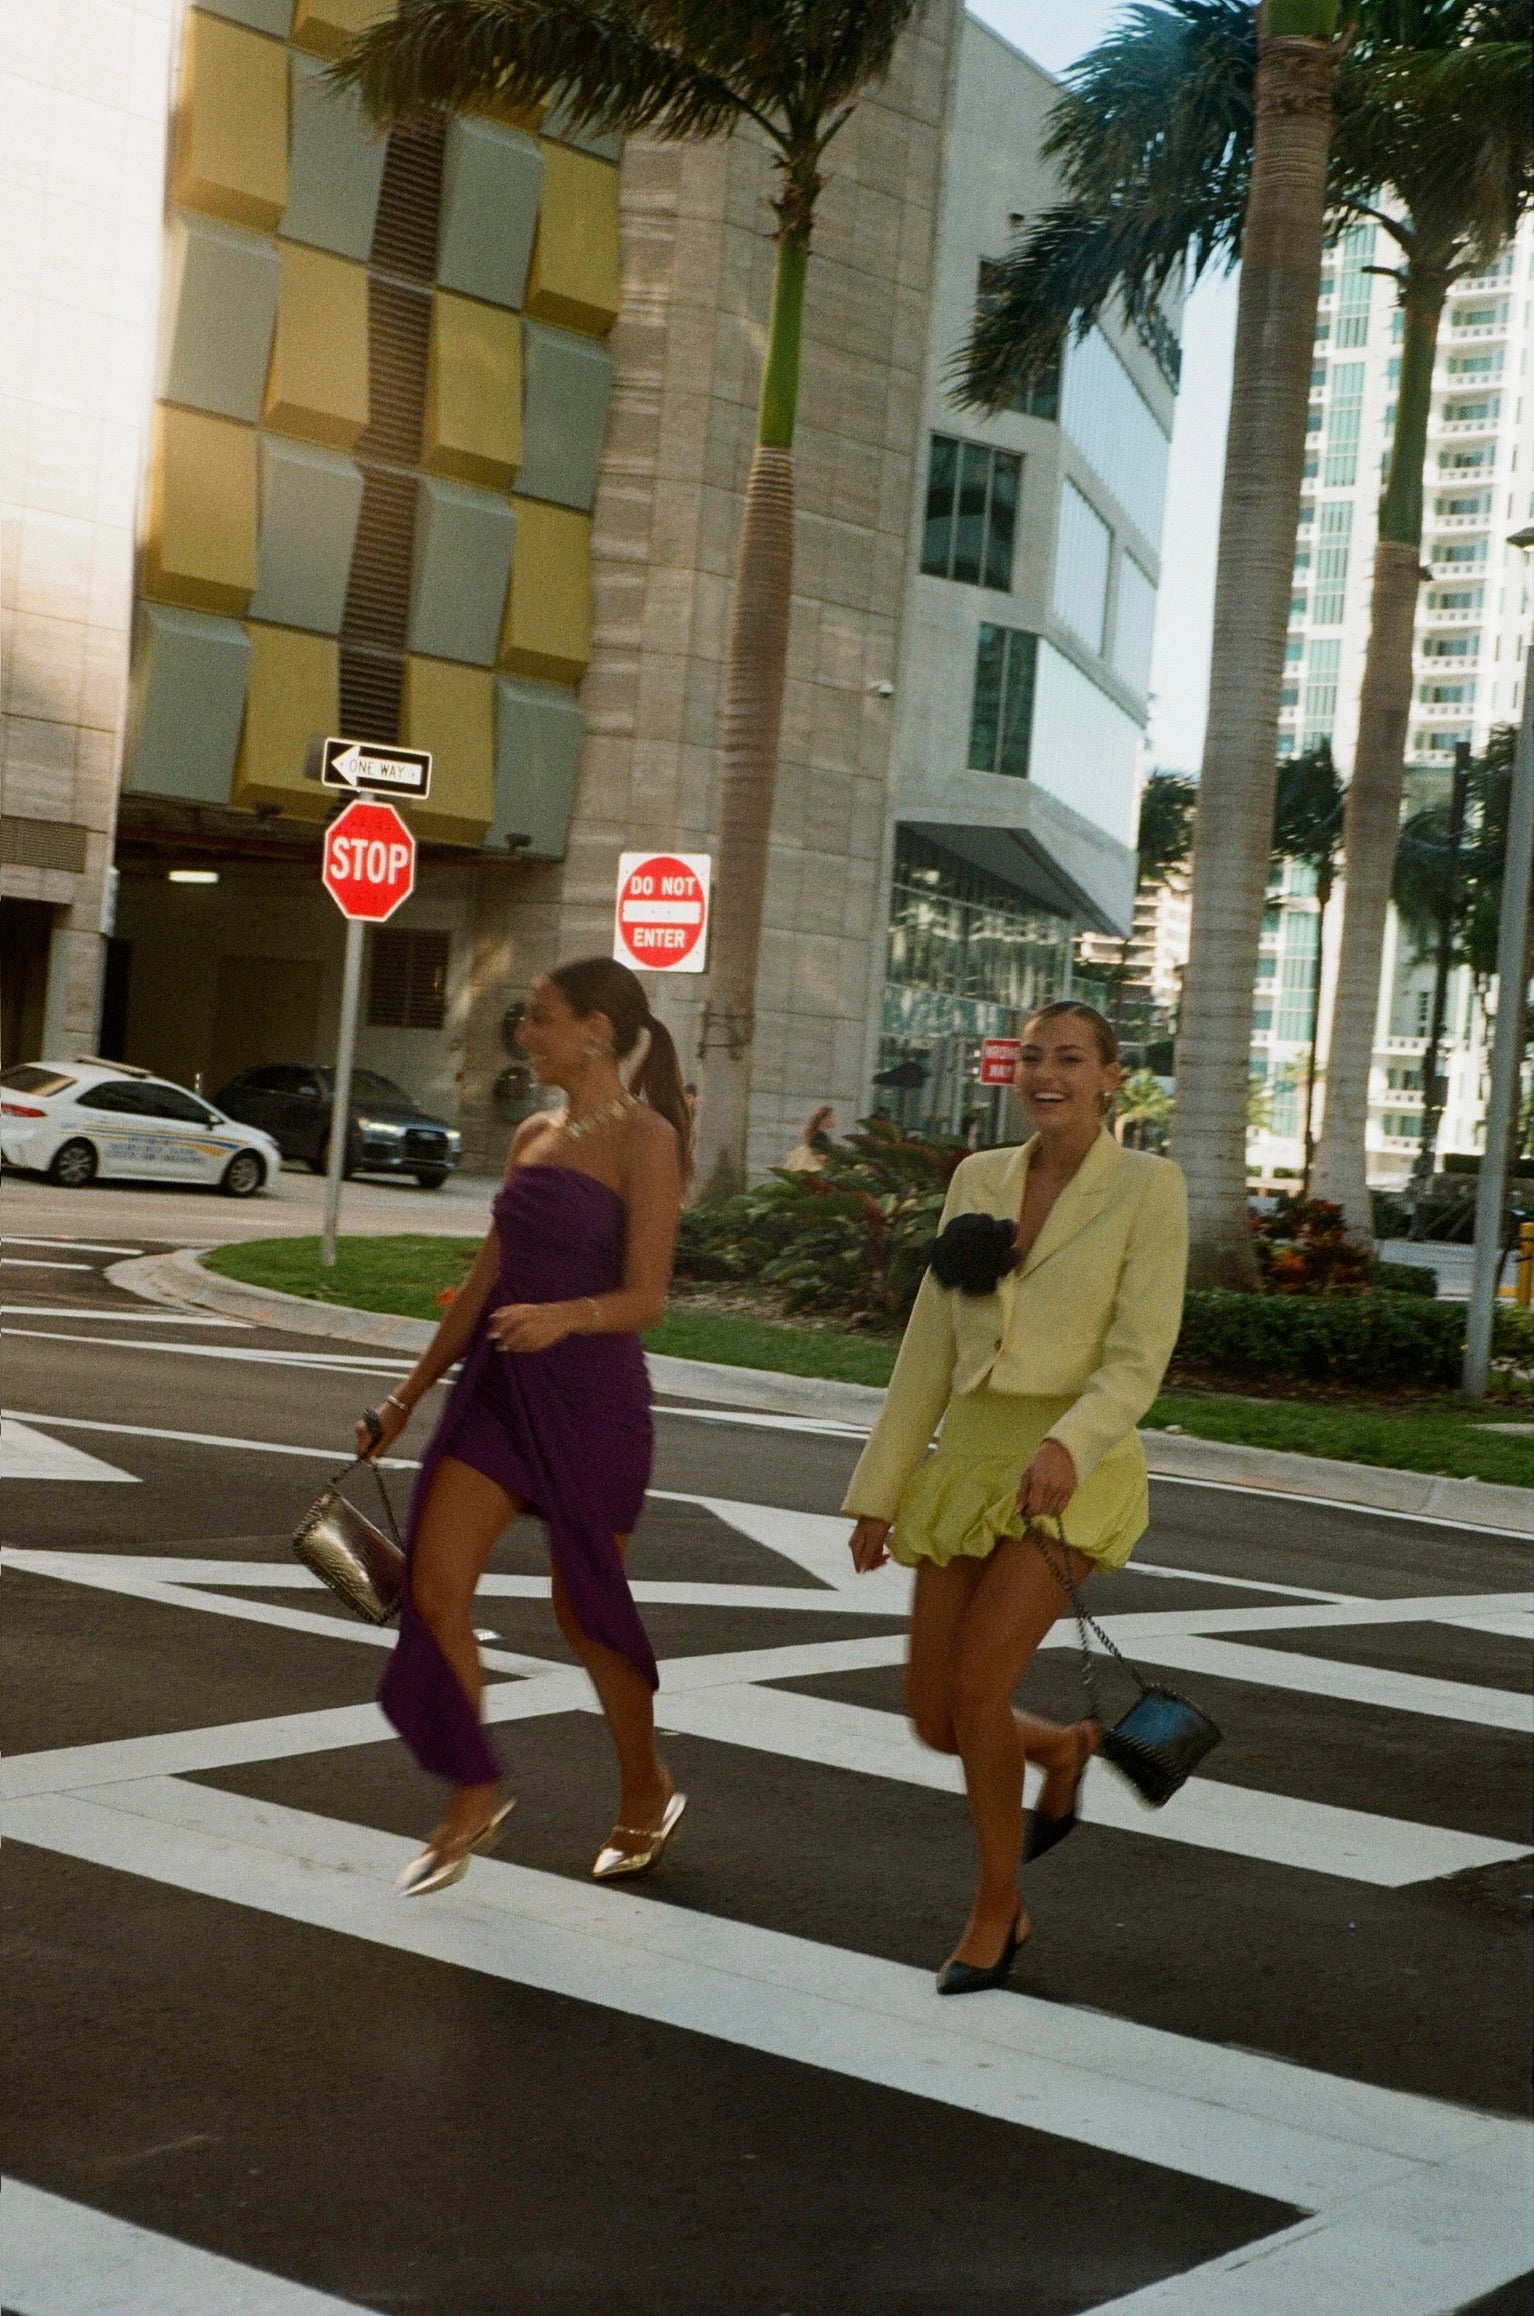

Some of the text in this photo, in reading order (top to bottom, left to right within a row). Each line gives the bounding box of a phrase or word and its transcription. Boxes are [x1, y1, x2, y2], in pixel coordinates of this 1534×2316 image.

[349, 759, 406, 779] ONE WAY
[330, 836, 409, 885] STOP
[630, 875, 696, 896] DO NOT
[633, 927, 686, 949] ENTER
